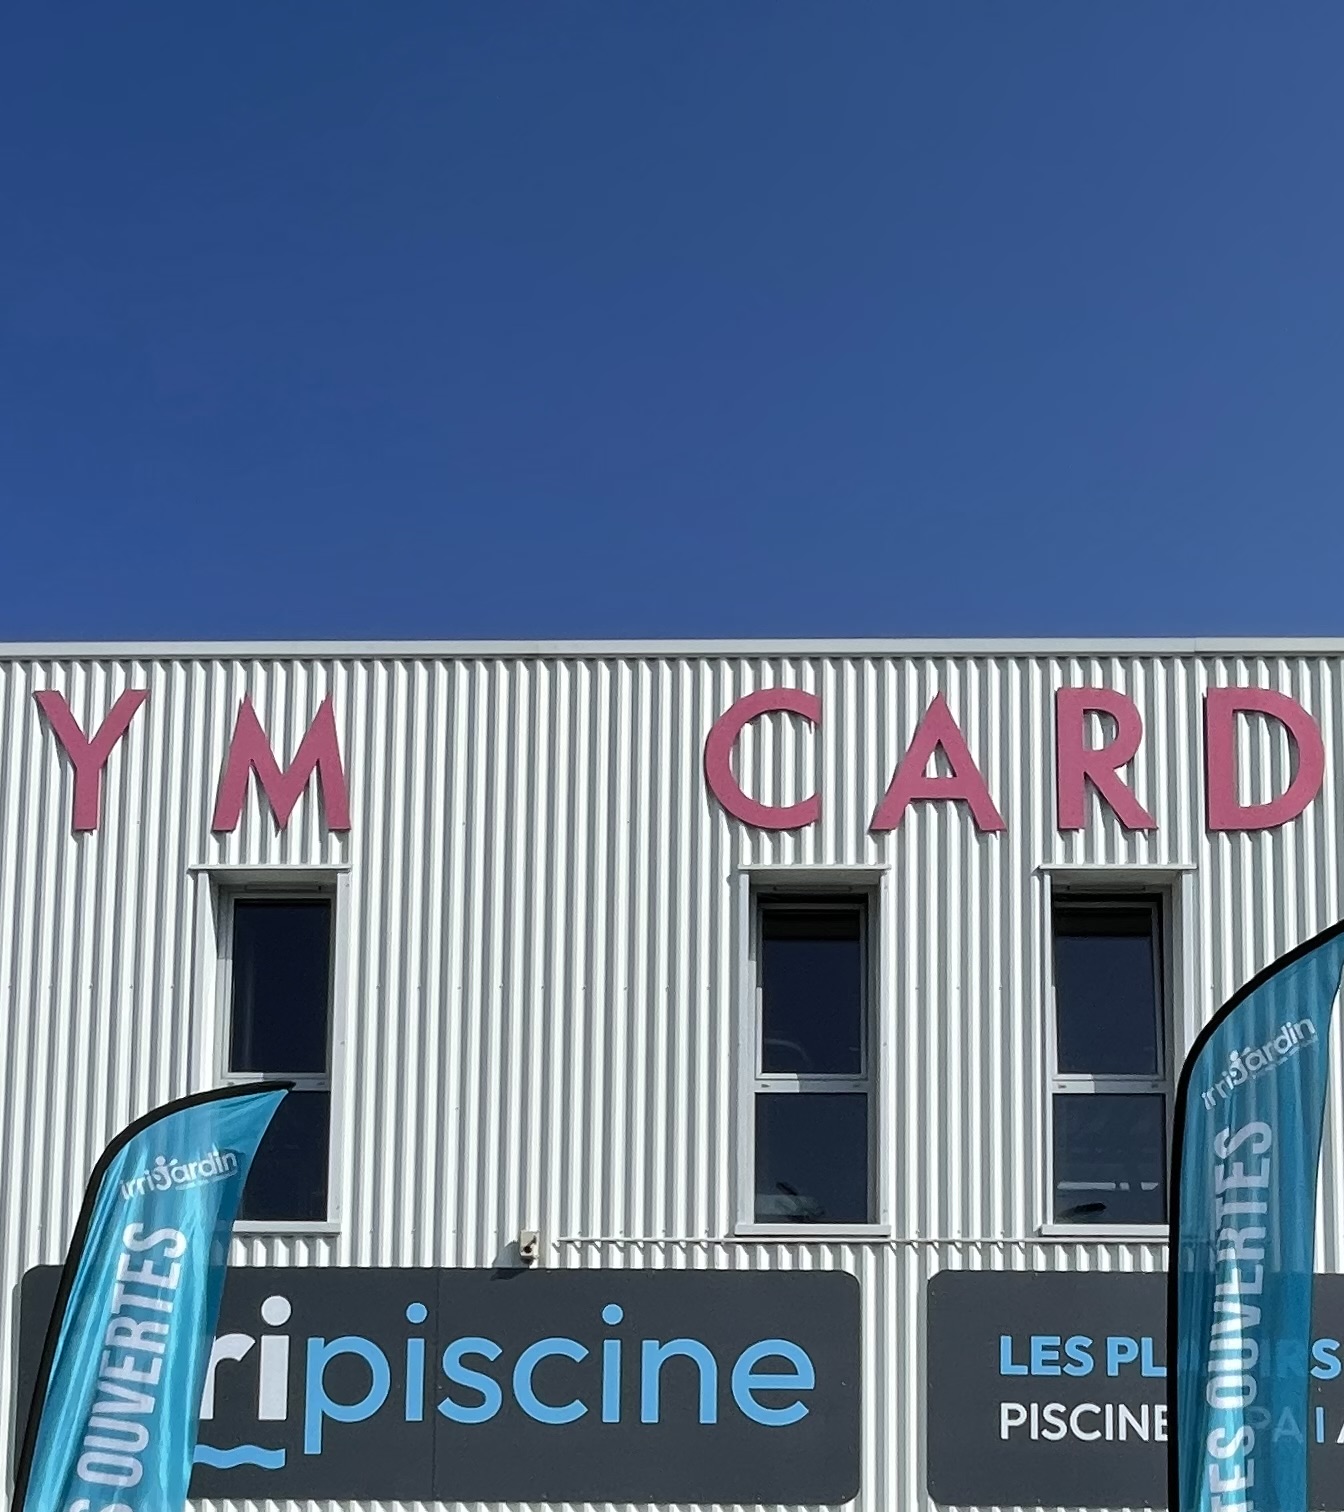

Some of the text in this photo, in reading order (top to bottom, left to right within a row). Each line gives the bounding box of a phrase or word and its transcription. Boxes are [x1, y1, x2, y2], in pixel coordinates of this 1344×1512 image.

[76, 1220, 189, 1489] OUVERTES
[998, 1335, 1092, 1377] LES
[1205, 1120, 1272, 1410] OUVERTES
[199, 1294, 816, 1456] ripiscine
